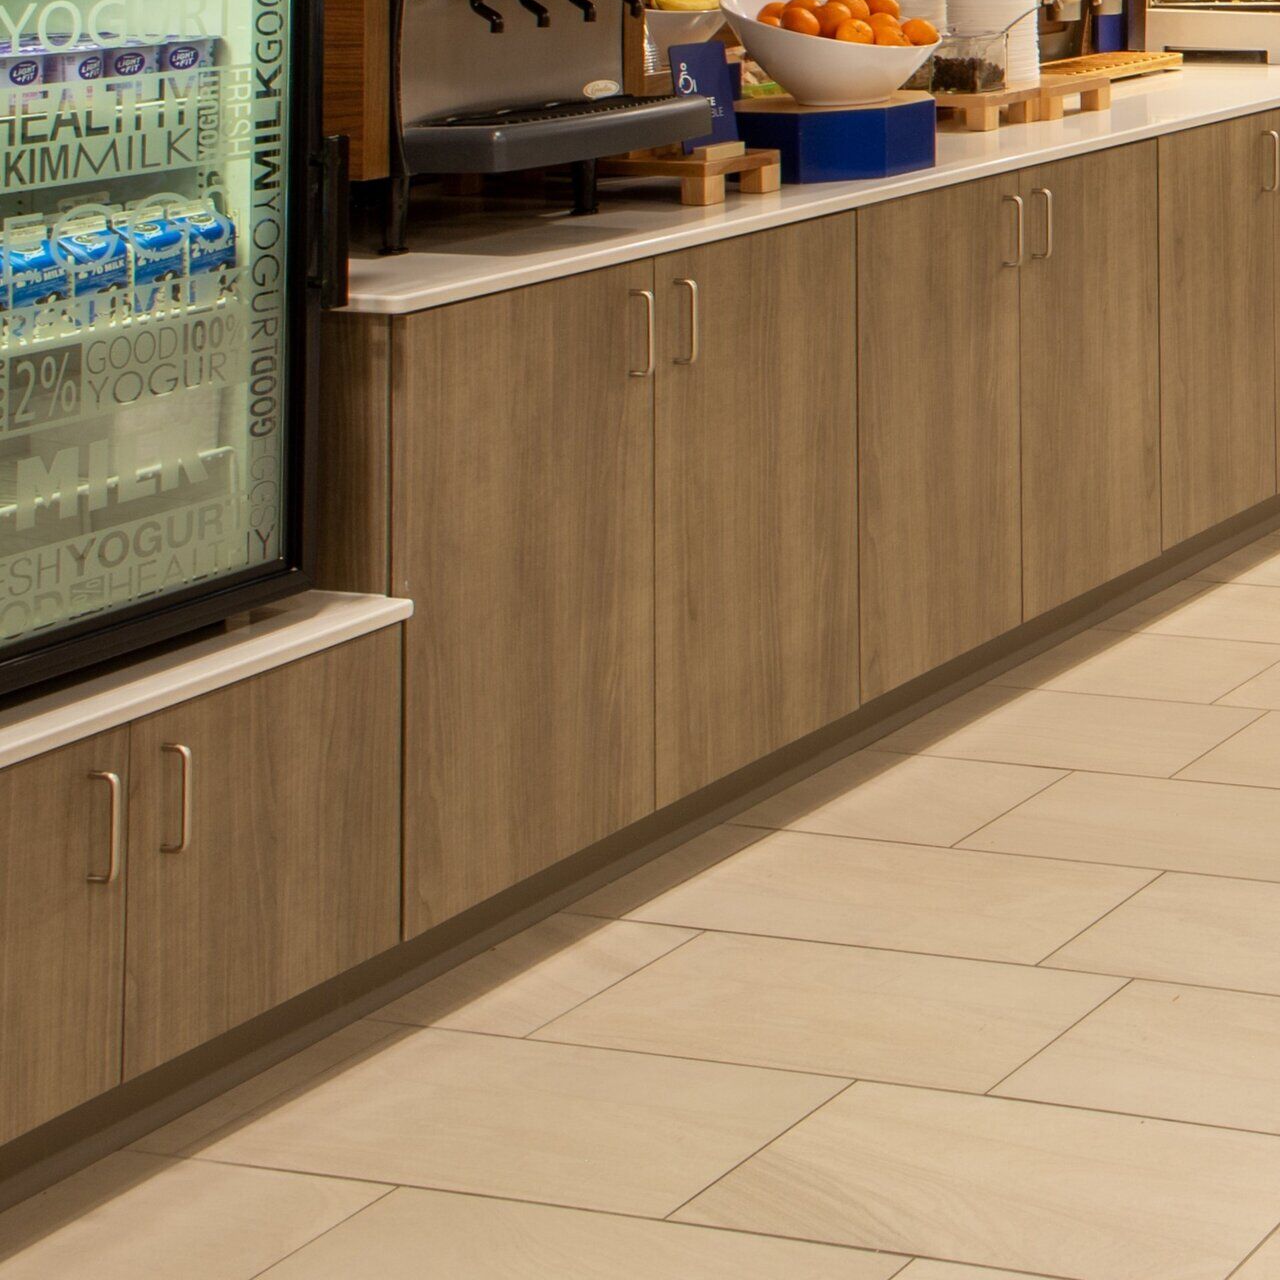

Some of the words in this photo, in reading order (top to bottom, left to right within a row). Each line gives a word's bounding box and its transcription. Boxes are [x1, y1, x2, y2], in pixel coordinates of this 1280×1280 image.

[73, 127, 192, 178] MILK
[254, 64, 283, 192] MILK
[252, 192, 282, 356] YOGURT
[86, 326, 178, 375] GOOD
[14, 351, 77, 424] 2%
